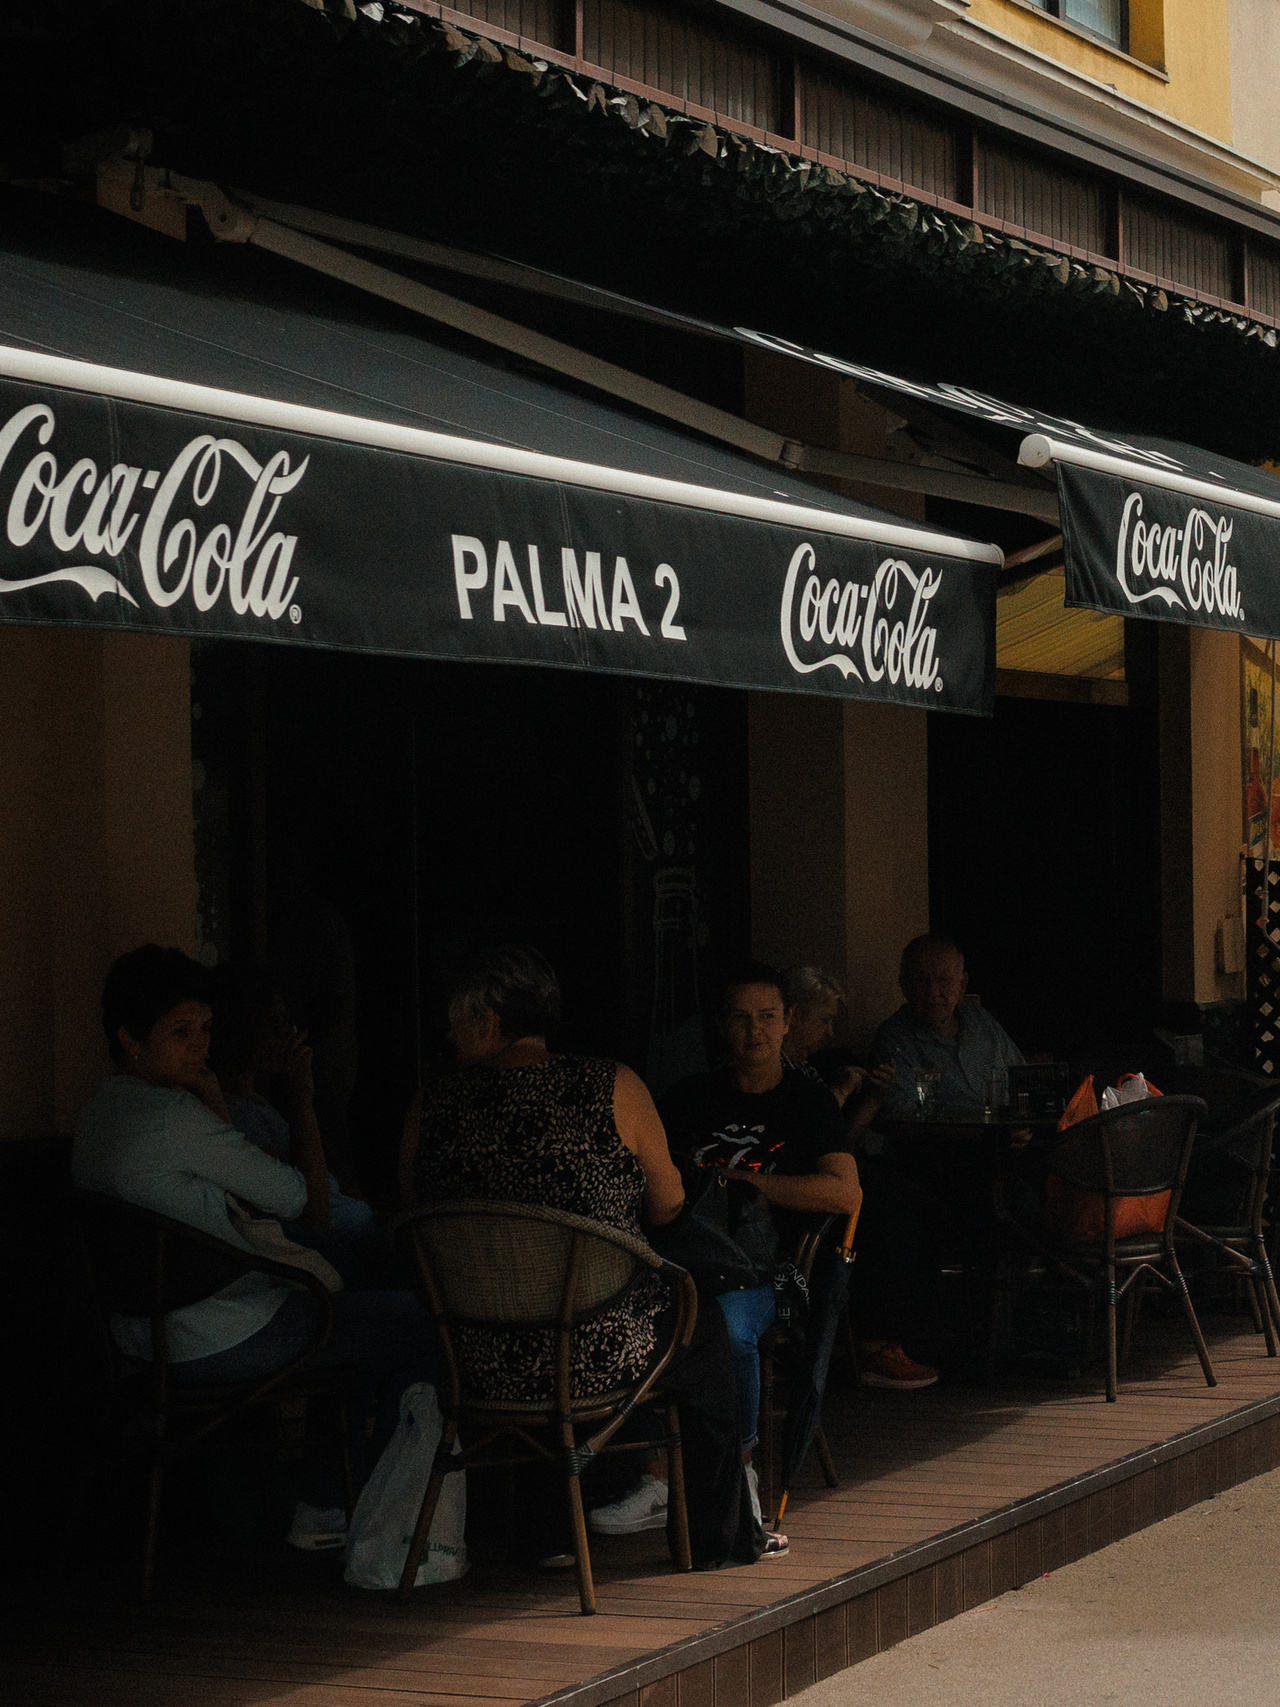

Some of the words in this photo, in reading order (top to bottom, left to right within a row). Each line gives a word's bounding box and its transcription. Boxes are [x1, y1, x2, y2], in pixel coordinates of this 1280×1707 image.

[451, 534, 650, 636] PALMA
[655, 563, 687, 641] 2
[781, 542, 943, 691] Coca-Cola
[1116, 491, 1245, 621] Coca-Cola
